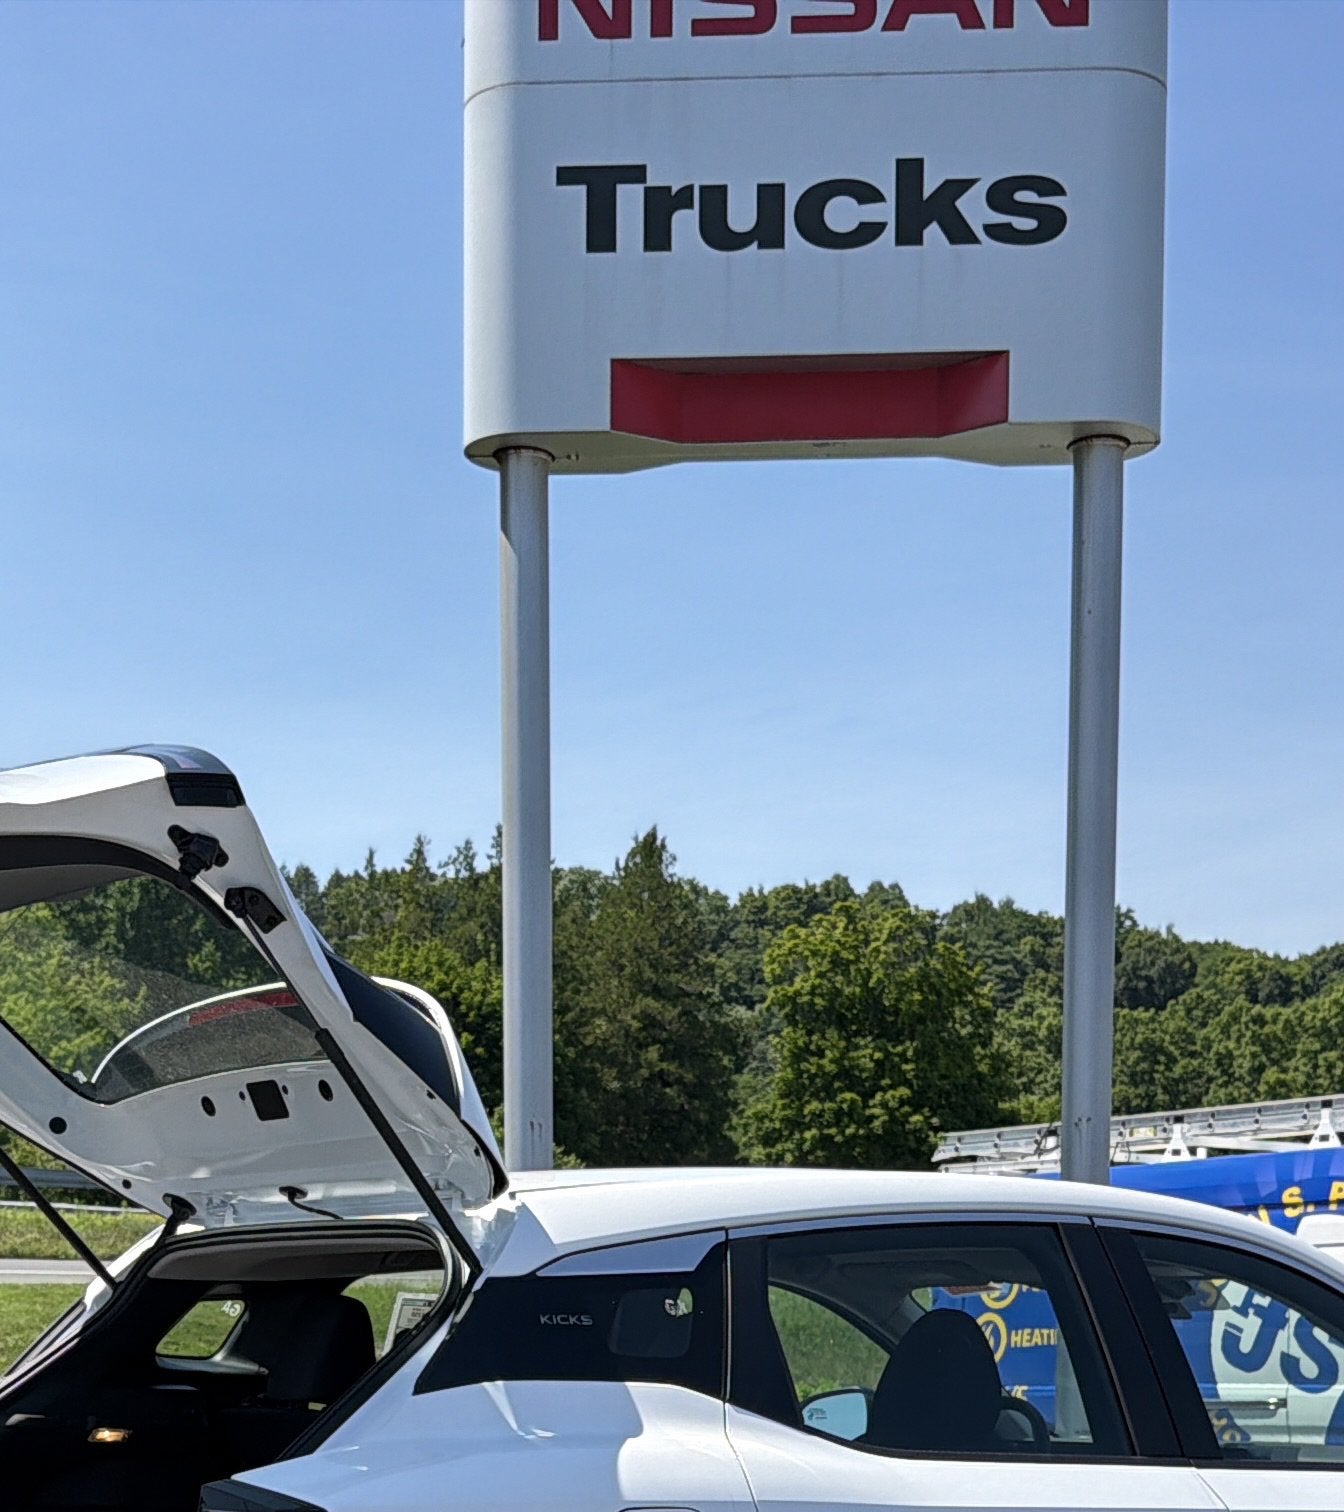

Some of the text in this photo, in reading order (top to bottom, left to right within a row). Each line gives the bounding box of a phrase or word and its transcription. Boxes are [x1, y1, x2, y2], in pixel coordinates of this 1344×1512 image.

[555, 157, 1068, 254] Trucks
[539, 1314, 593, 1326] KICKS
[1010, 1327, 1057, 1349] HEATI
